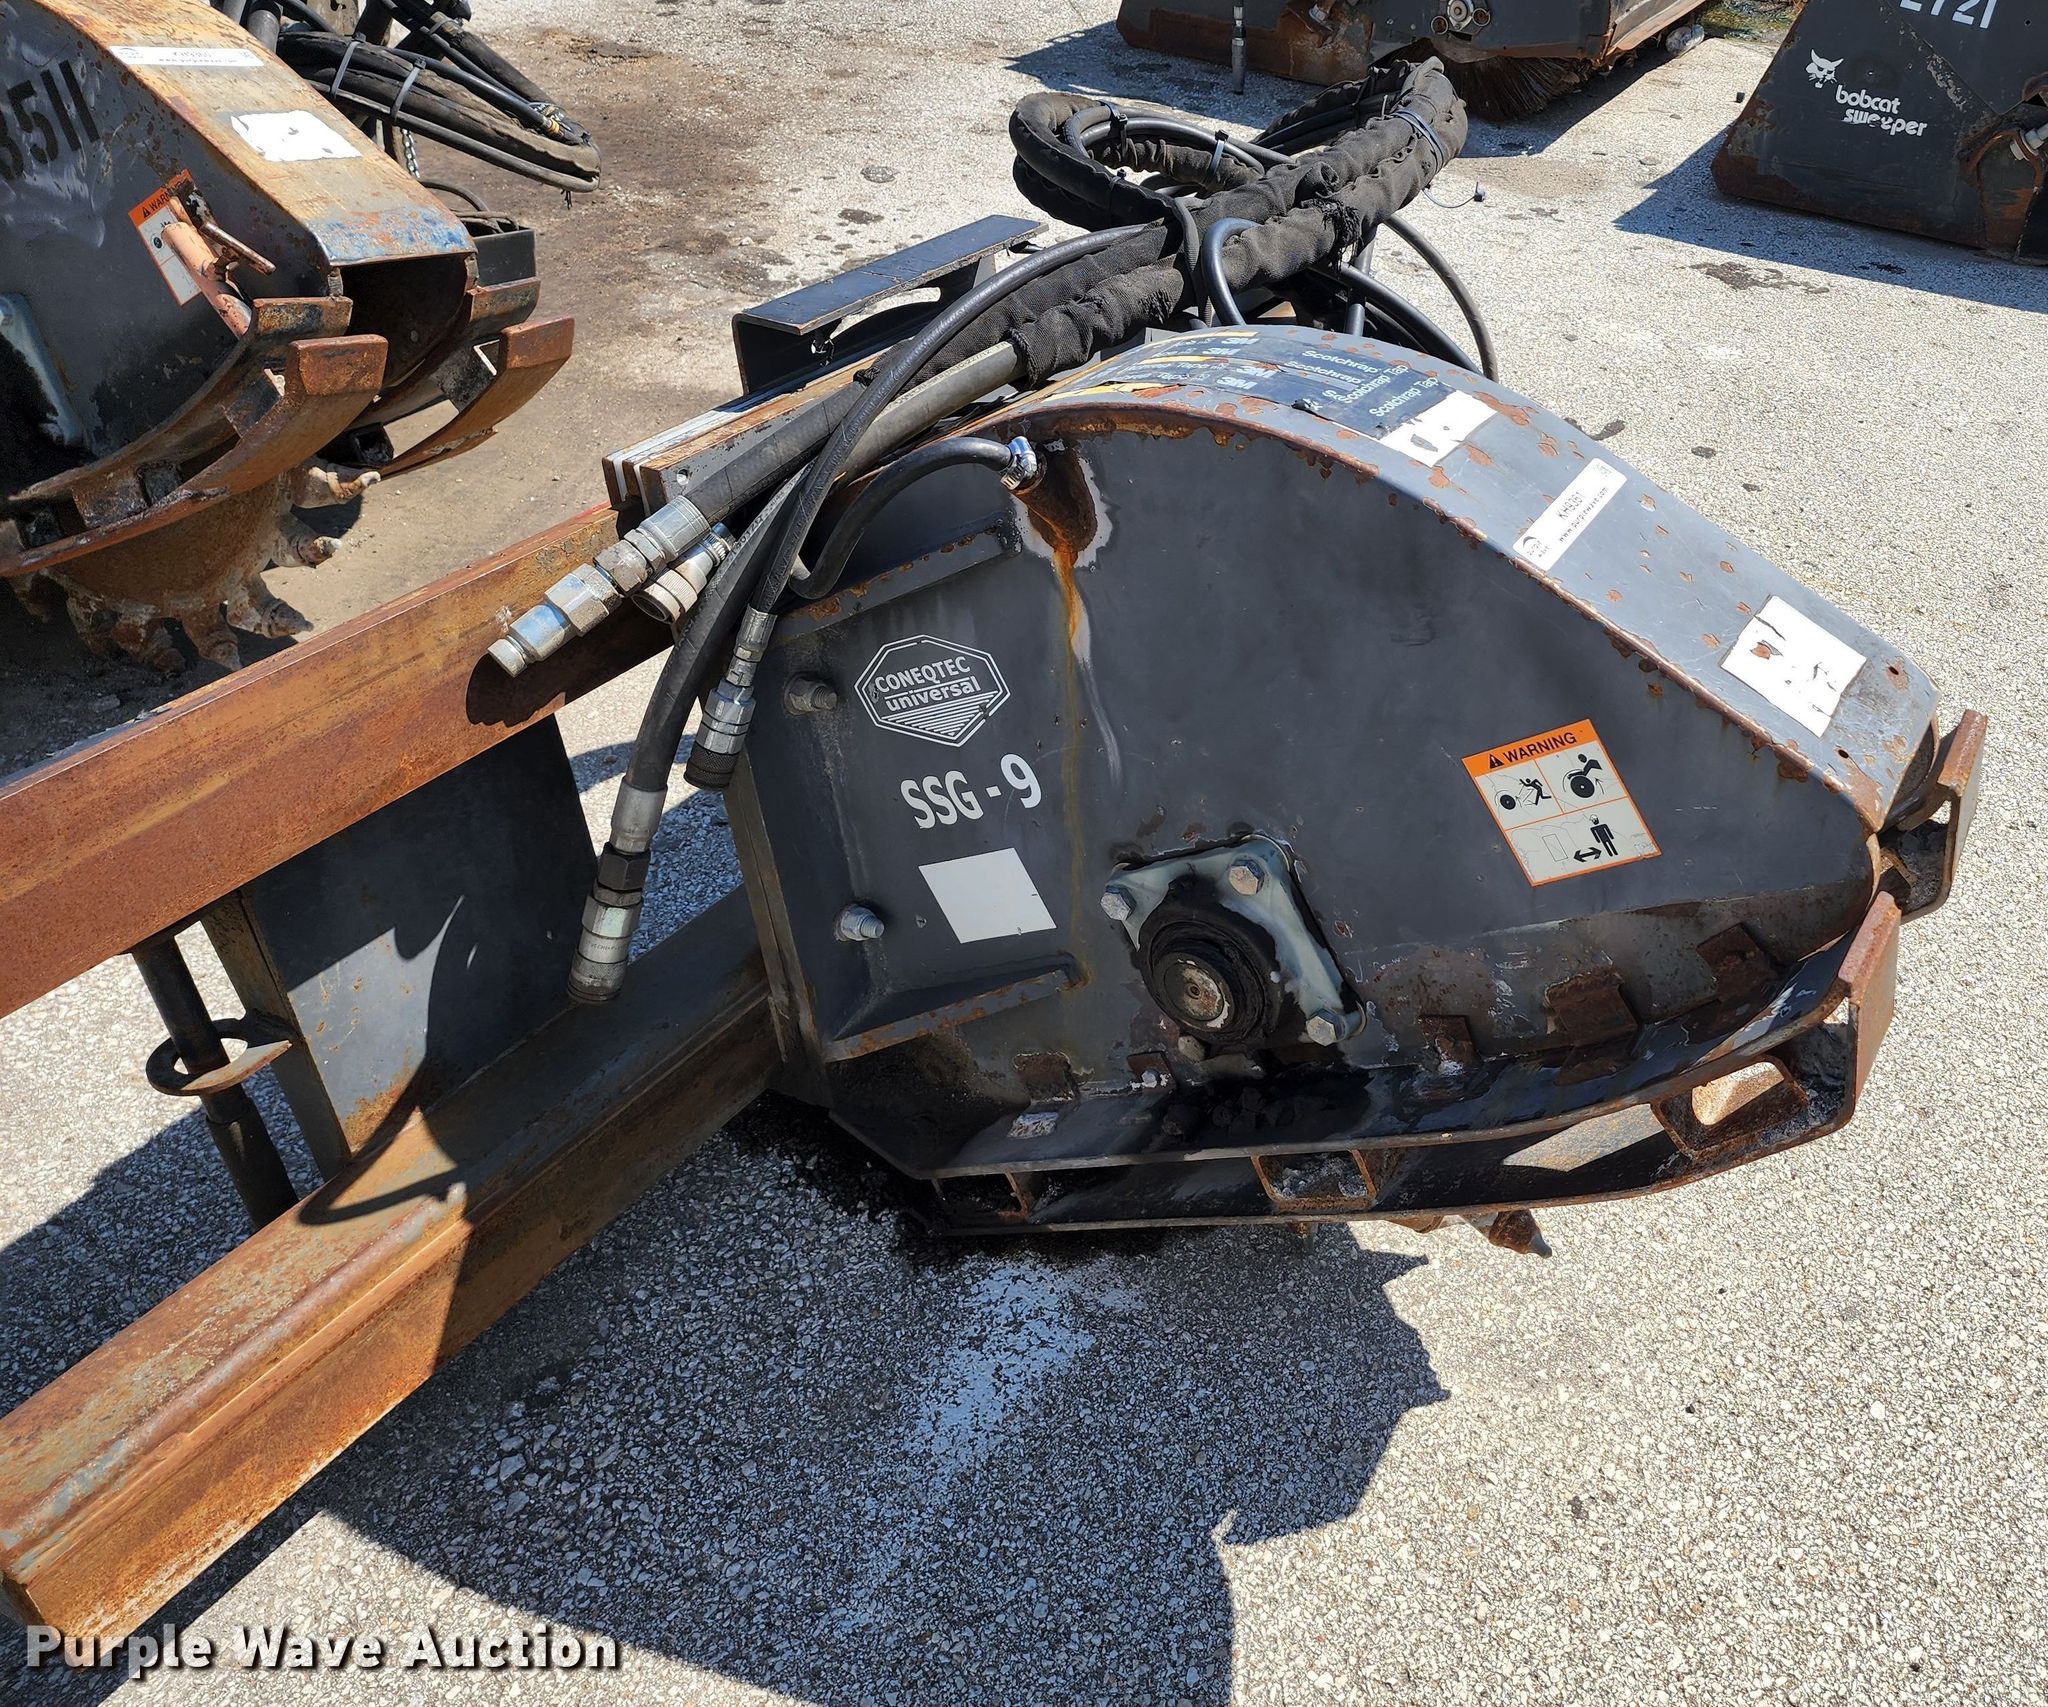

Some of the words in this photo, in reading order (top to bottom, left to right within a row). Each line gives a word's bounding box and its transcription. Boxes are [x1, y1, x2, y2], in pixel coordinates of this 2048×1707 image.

[1835, 84, 1901, 115] bobcat
[1202, 347, 1241, 355] 3M
[1221, 337, 1260, 345] 3M
[1236, 365, 1278, 378] 3M
[1284, 360, 1362, 384] Scotchrap
[1302, 350, 1379, 374] Scotchrap
[1216, 376, 1258, 390] 3M
[1338, 374, 1391, 404] Scotchrap
[1369, 387, 1422, 417] Scotchrap
[874, 656, 971, 693] CONEQTEC
[885, 675, 982, 712] universal
[1502, 732, 1577, 763] WARNING
